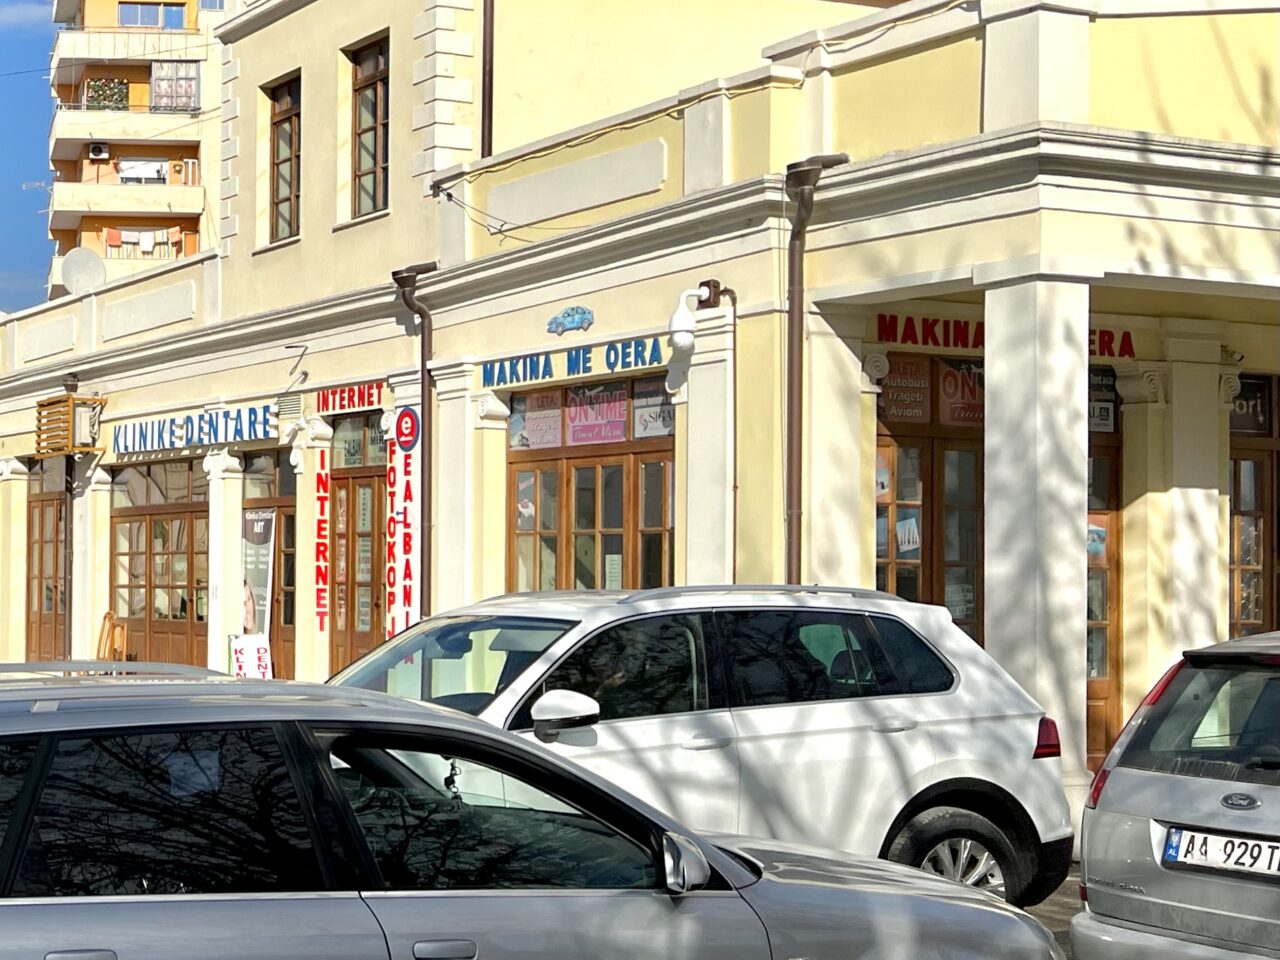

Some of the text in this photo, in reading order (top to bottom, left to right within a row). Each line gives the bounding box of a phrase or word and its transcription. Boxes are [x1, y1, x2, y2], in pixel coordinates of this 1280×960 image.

[877, 313, 985, 349] MAKINA
[1089, 329, 1136, 358] ERA
[482, 337, 663, 388] MAKINA ME QERA
[316, 381, 384, 413] INTERNET
[941, 368, 978, 401] ON
[112, 405, 271, 454] KLINIKE DENTARE
[315, 449, 329, 632] INTERNET
[386, 440, 397, 640] FOTOKOPJ
[234, 648, 246, 679] KLIN
[256, 647, 268, 679] DENT
[1223, 839, 1263, 868] 929
[1267, 845, 1280, 872] T
